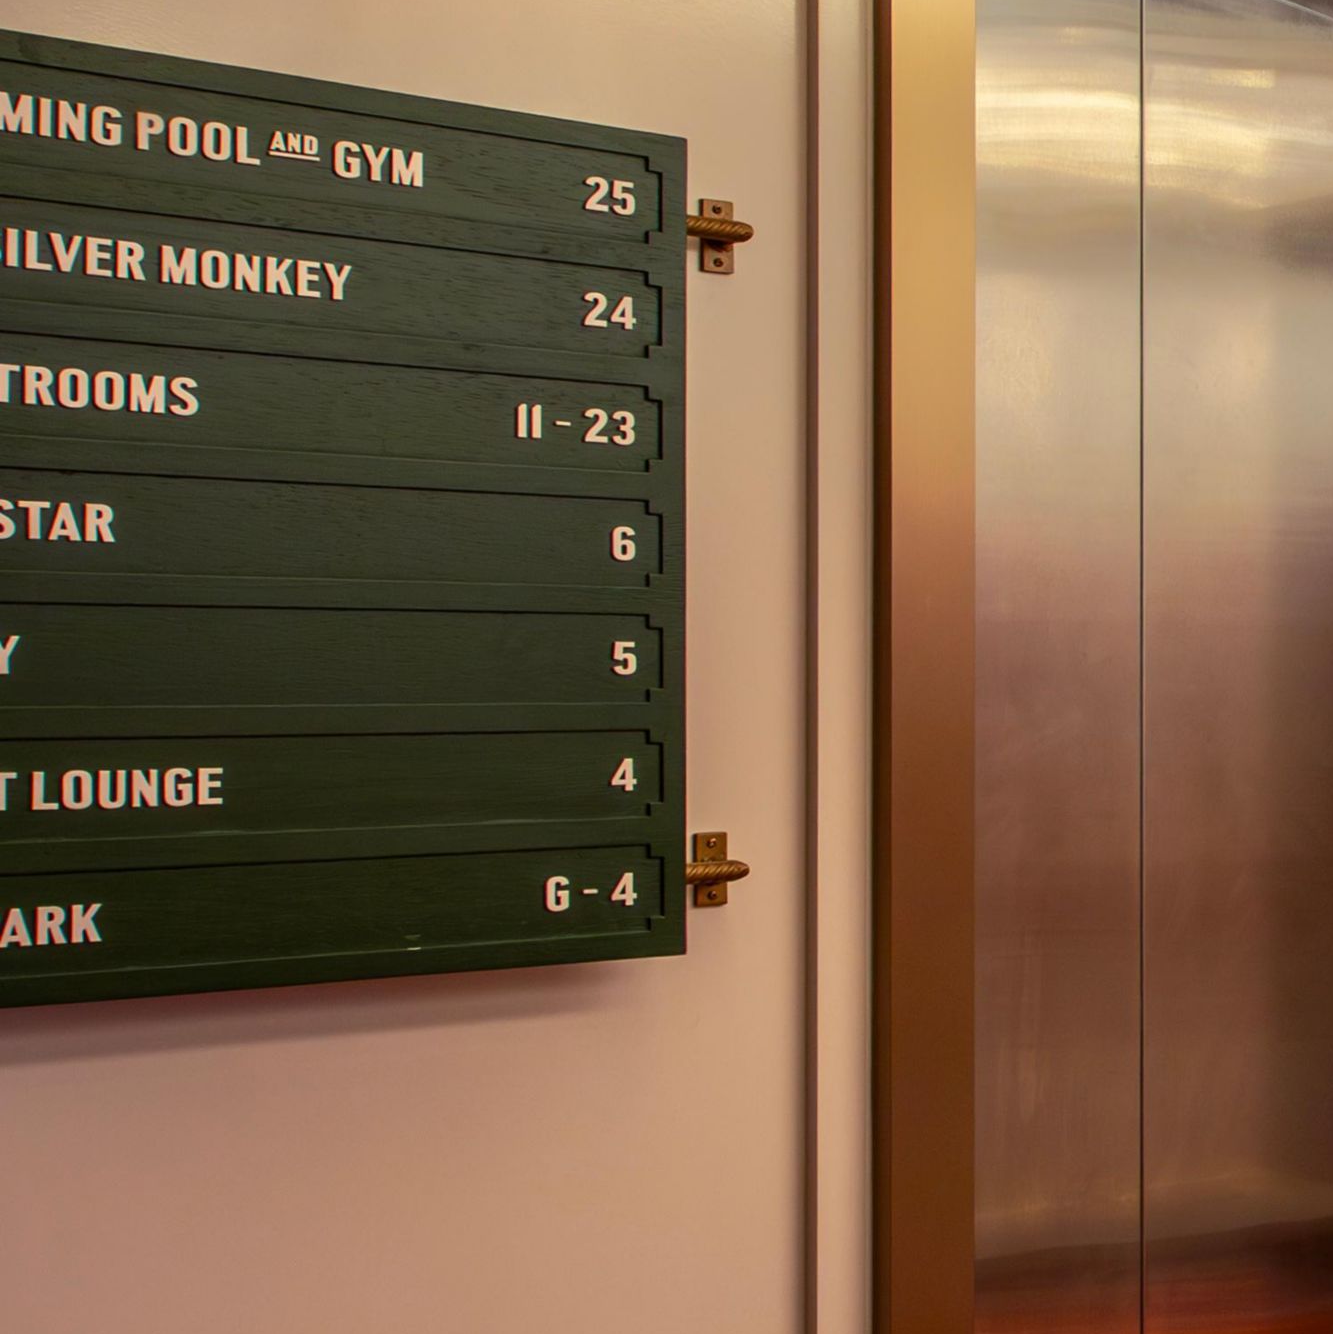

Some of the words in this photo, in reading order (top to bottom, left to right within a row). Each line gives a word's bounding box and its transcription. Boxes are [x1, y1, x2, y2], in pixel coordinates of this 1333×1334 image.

[0, 92, 121, 145] MING
[137, 112, 260, 165] POOL
[270, 131, 320, 157] AND
[335, 141, 422, 186] GYM
[586, 177, 635, 214] 25
[0, 228, 145, 280] ILVER
[162, 245, 351, 299] MONKEY
[585, 293, 636, 329] 24
[585, 409, 634, 445] 23
[613, 527, 635, 560] 6
[614, 642, 636, 674] 5
[32, 768, 223, 810] LOUNGE
[612, 758, 636, 791] 4
[0, 904, 101, 948] ARK
[546, 876, 569, 911] G
[612, 873, 637, 905] 4
